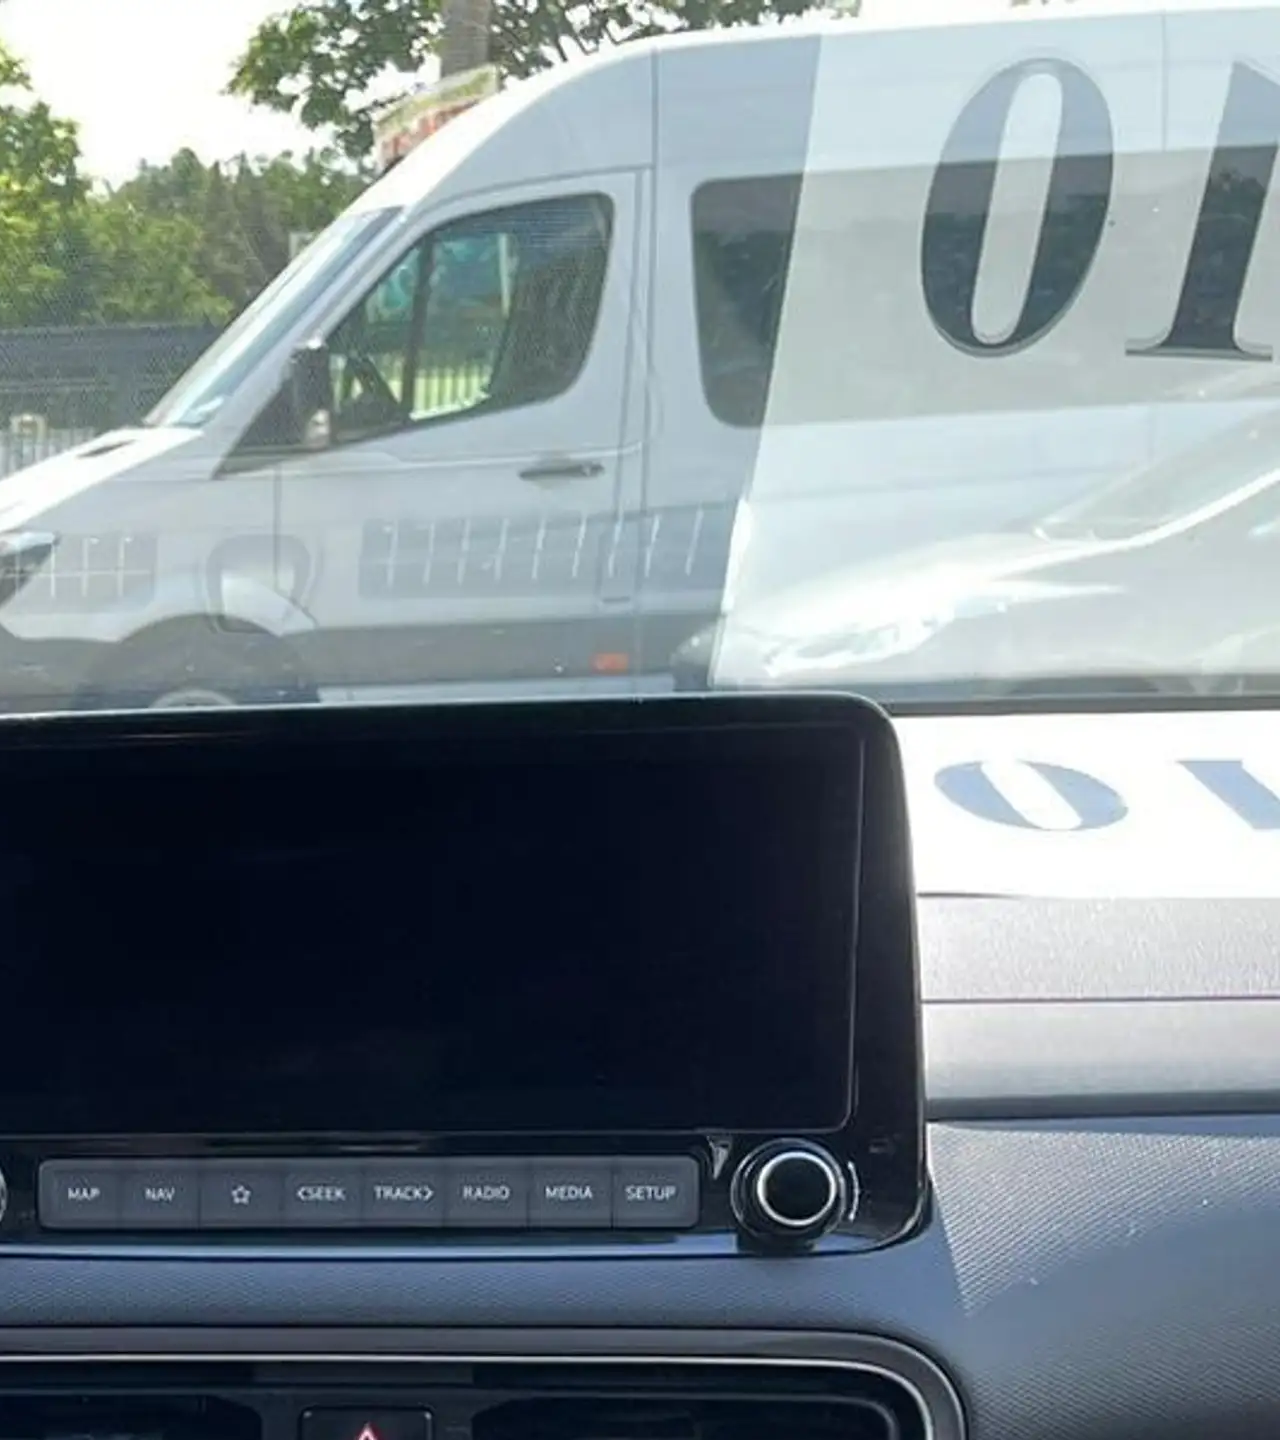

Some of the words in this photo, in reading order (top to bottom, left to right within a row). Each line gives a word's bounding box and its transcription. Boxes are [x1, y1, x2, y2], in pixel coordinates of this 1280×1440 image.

[68, 1187, 101, 1201] MAP
[145, 1188, 176, 1201] NAV
[463, 1186, 510, 1200] RADIO
[545, 1187, 593, 1200] MEDIA
[626, 1186, 676, 1201] SETUP
